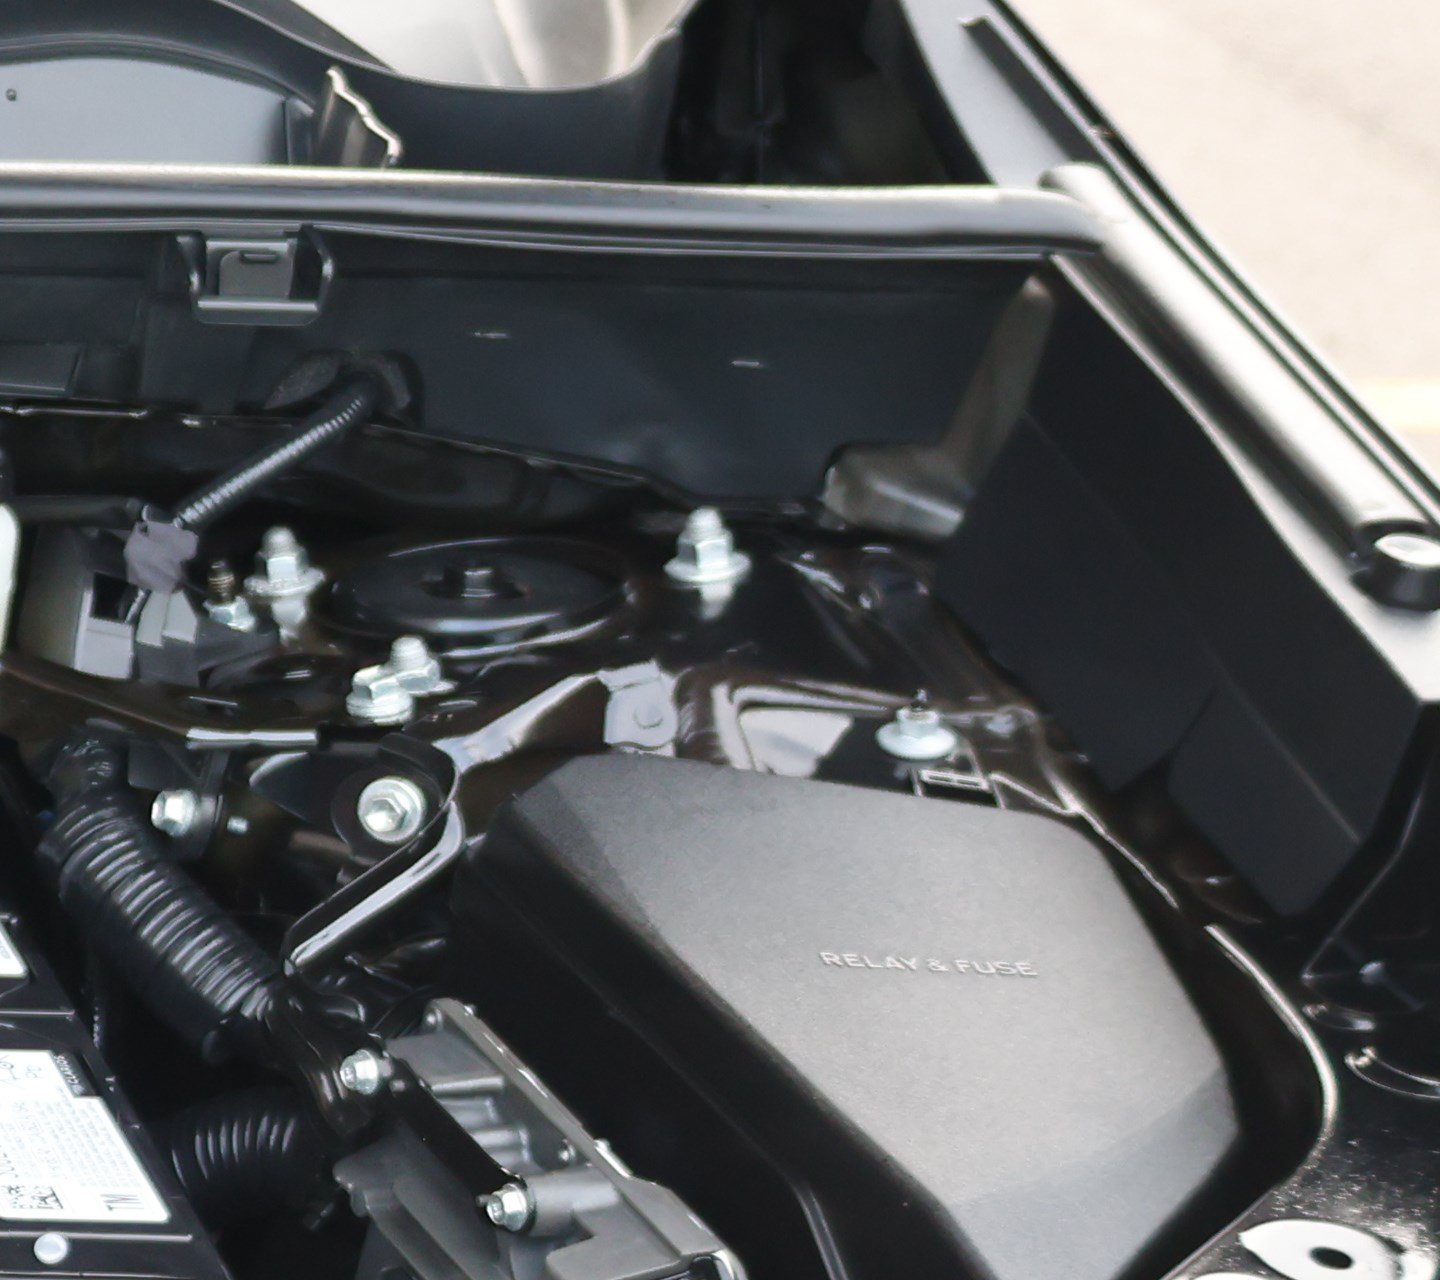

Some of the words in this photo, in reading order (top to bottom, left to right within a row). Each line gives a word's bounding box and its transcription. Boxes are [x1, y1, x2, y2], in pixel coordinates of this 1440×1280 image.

[818, 950, 918, 971] RELAY
[926, 957, 949, 972] &
[953, 958, 1039, 977] FUSE
